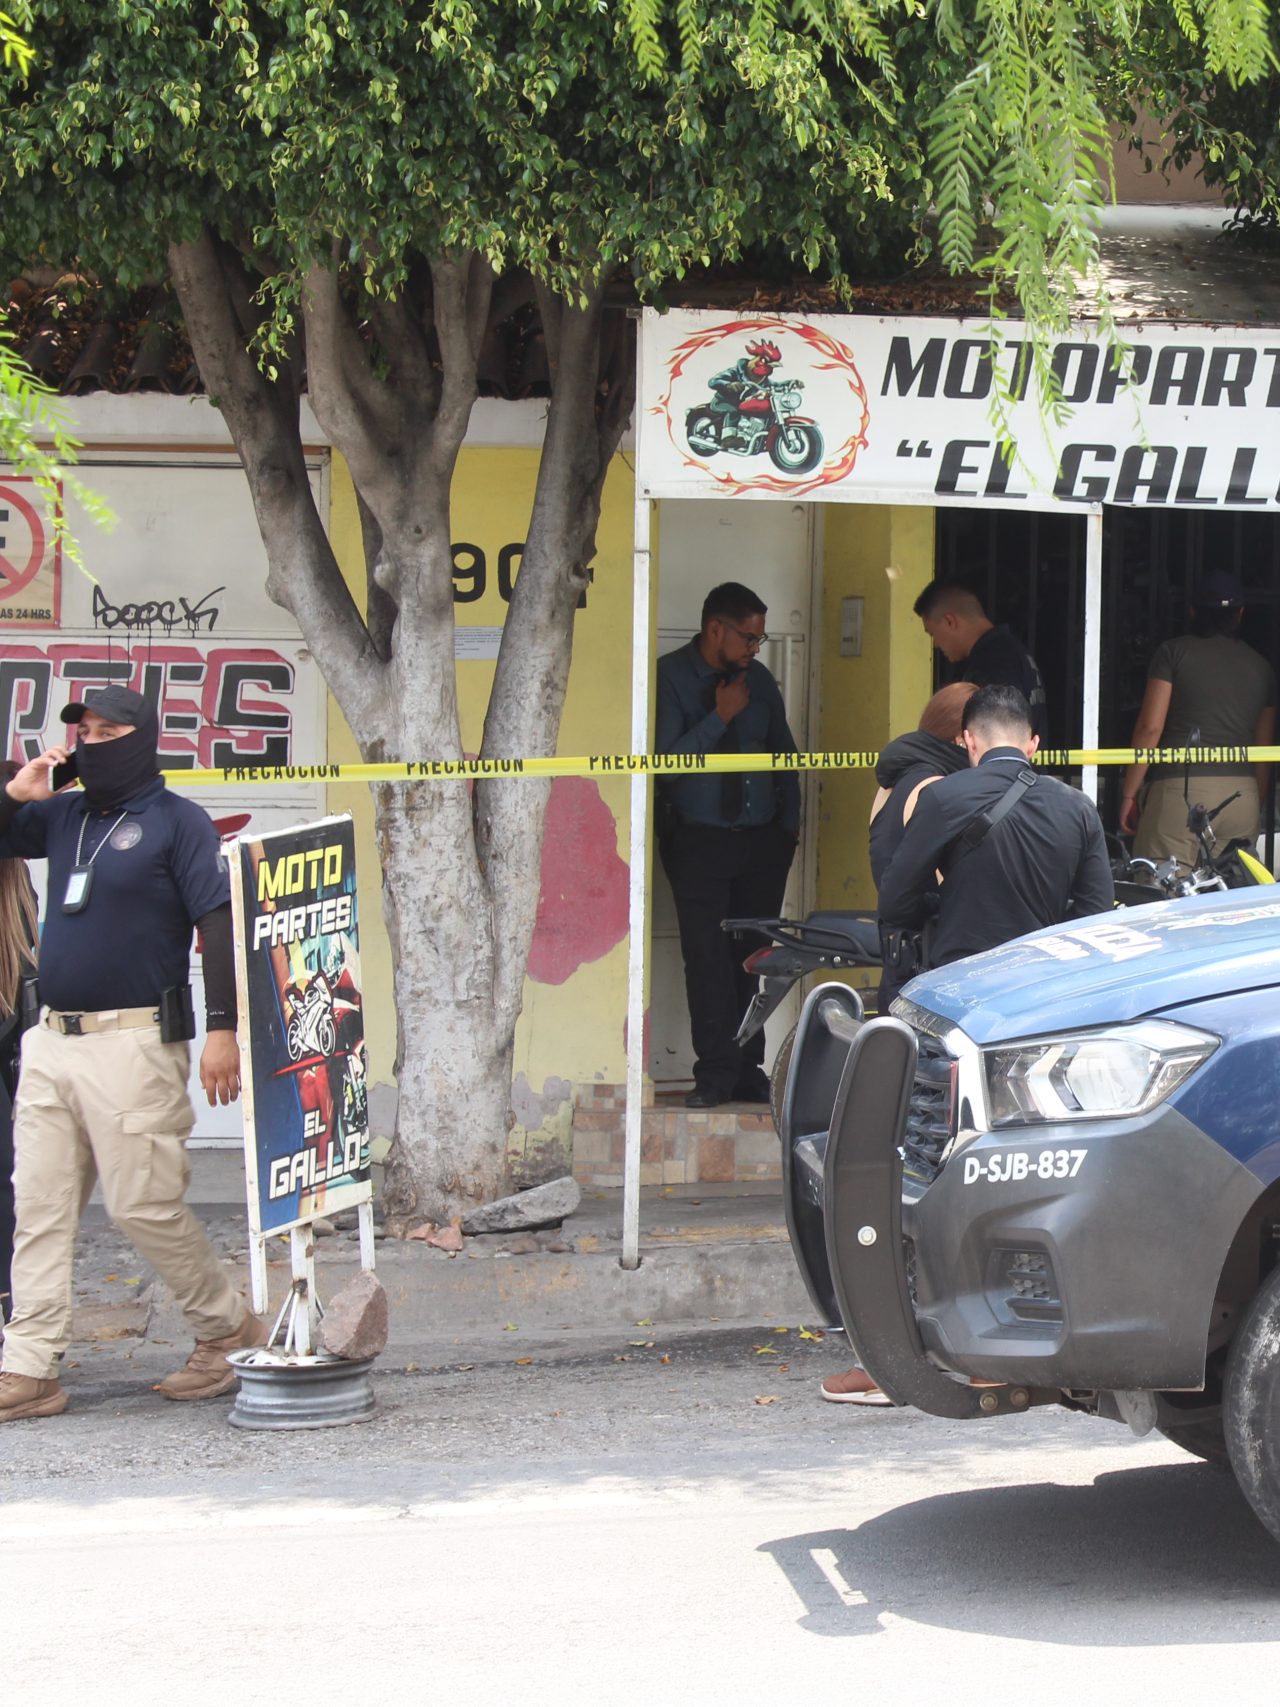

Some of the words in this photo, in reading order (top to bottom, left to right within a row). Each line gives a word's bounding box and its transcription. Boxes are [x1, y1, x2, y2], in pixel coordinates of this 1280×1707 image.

[16, 608, 29, 620] 24
[30, 608, 52, 620] HRS
[1135, 746, 1248, 764] PRECAUCION
[258, 844, 342, 902] MOTO
[253, 895, 351, 951] PARTES
[304, 1109, 326, 1138] EL
[269, 1131, 361, 1200] GALLO
[963, 1149, 1088, 1185] D-SJB-837
